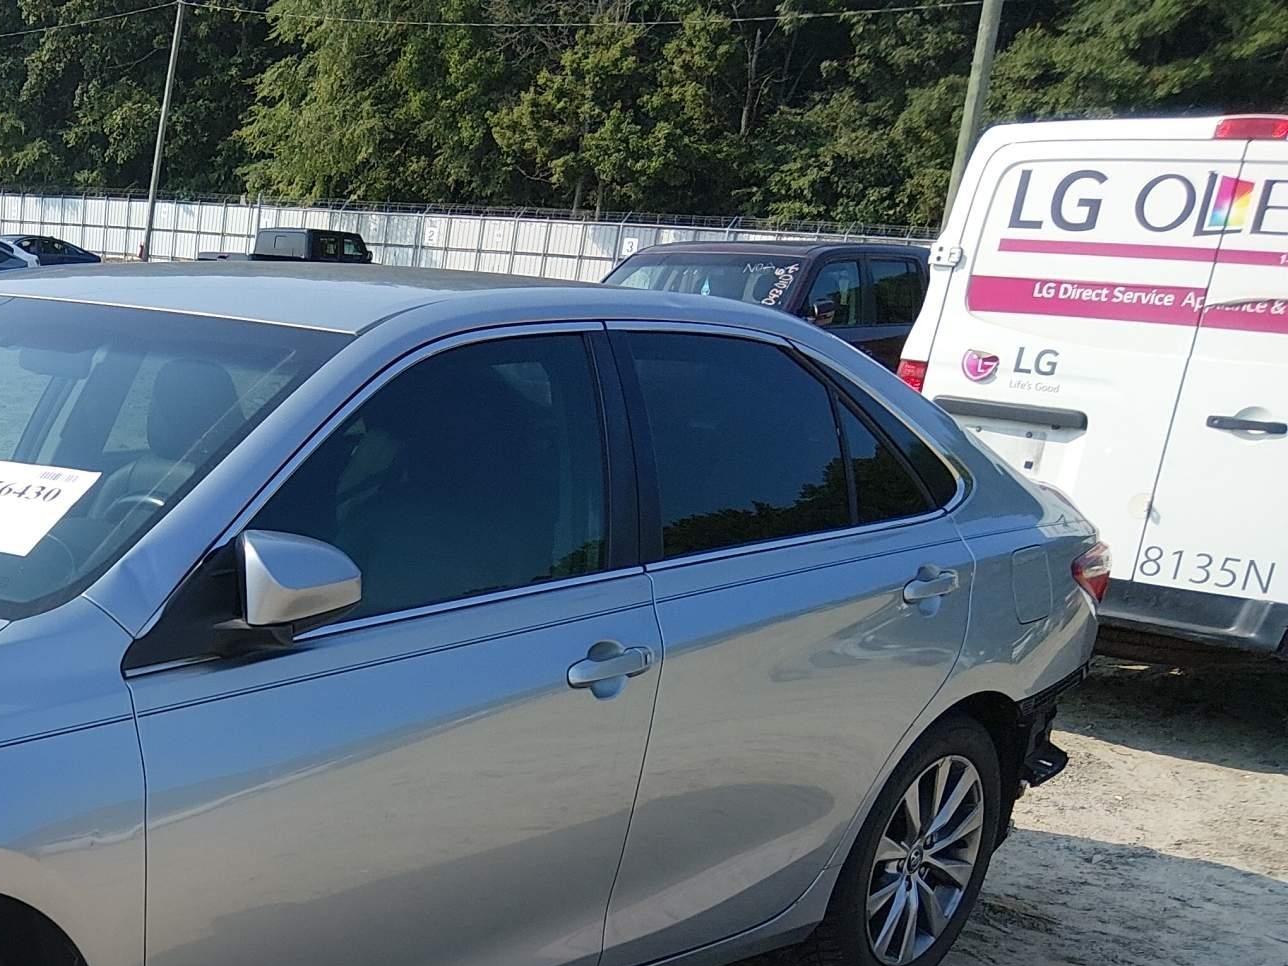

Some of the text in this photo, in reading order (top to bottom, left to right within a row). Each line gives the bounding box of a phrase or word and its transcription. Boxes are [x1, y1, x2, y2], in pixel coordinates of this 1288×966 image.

[1008, 169, 1108, 232] LG
[1033, 282, 1056, 298] LG
[1059, 283, 1109, 302] Direct
[1112, 287, 1175, 306] Service
[1013, 346, 1060, 376] LG
[1009, 380, 1061, 393] Life's Good
[1139, 545, 1276, 594] 8135N
